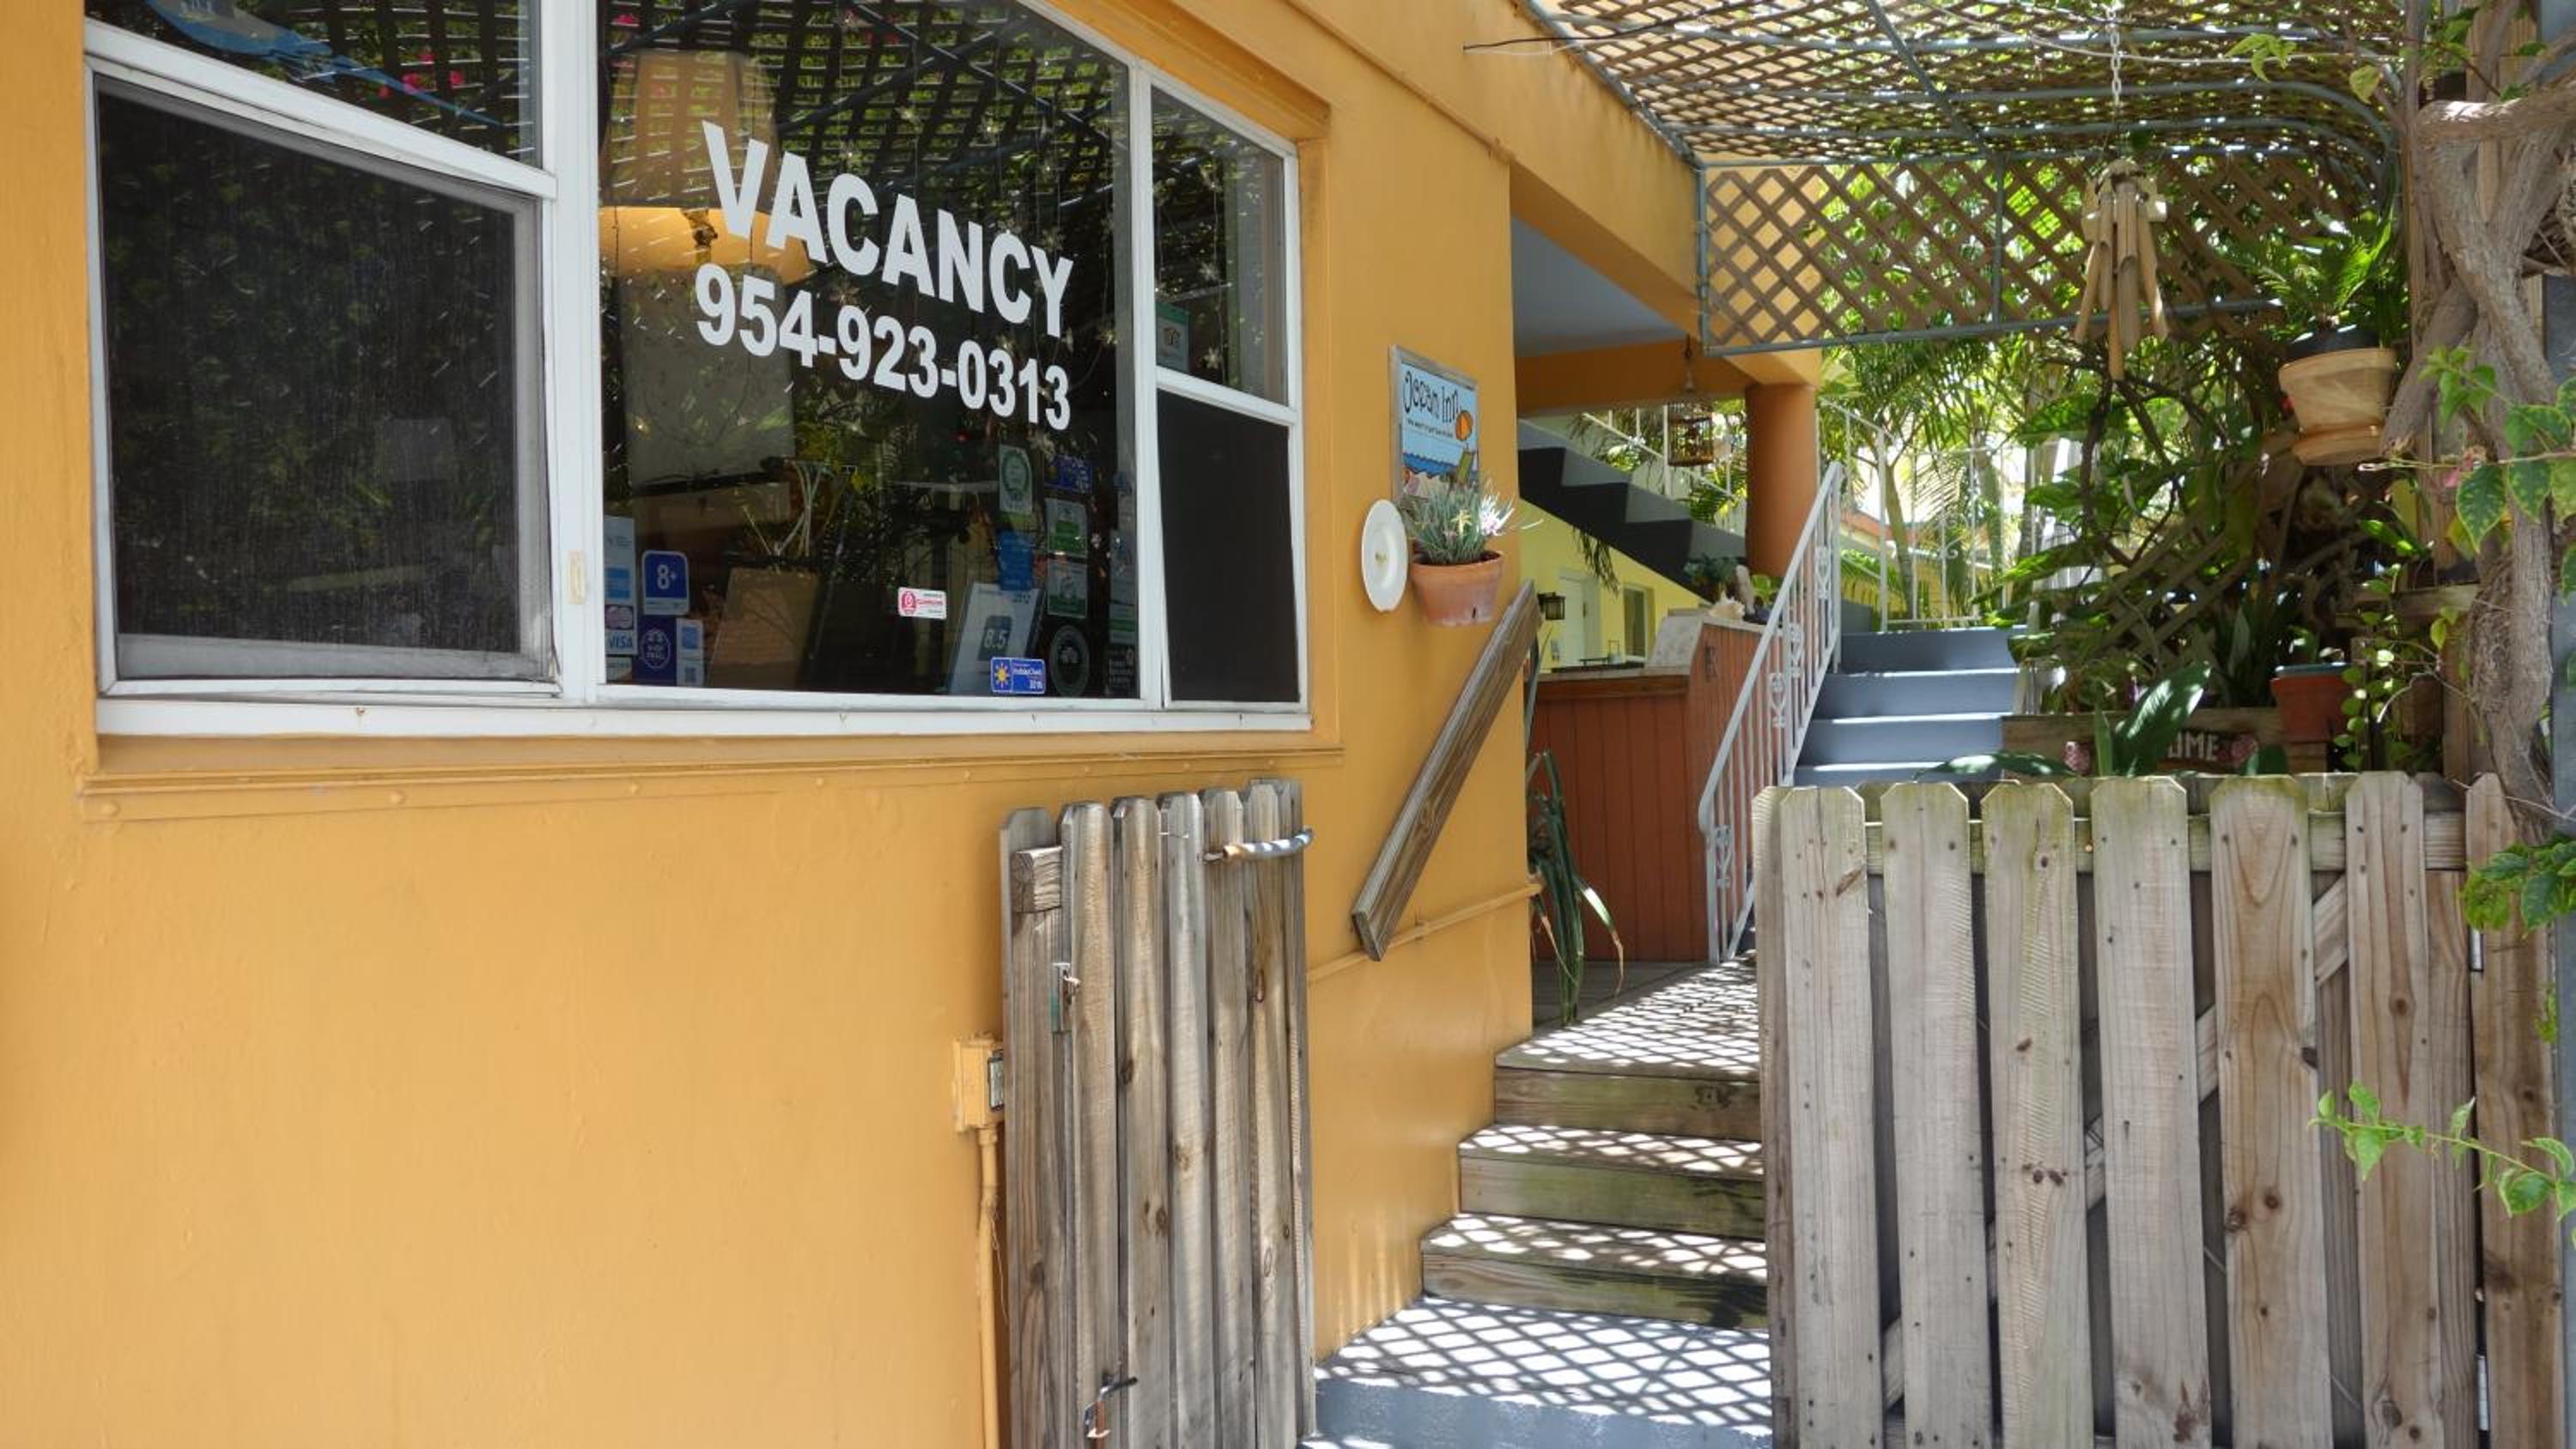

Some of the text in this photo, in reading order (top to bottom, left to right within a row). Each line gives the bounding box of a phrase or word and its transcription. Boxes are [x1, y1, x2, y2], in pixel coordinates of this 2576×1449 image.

[702, 120, 1073, 338] VACANCY
[695, 263, 1071, 431] 954-923-0313
[1403, 370, 1461, 423] Ocean Inn
[609, 635, 634, 648] VISA
